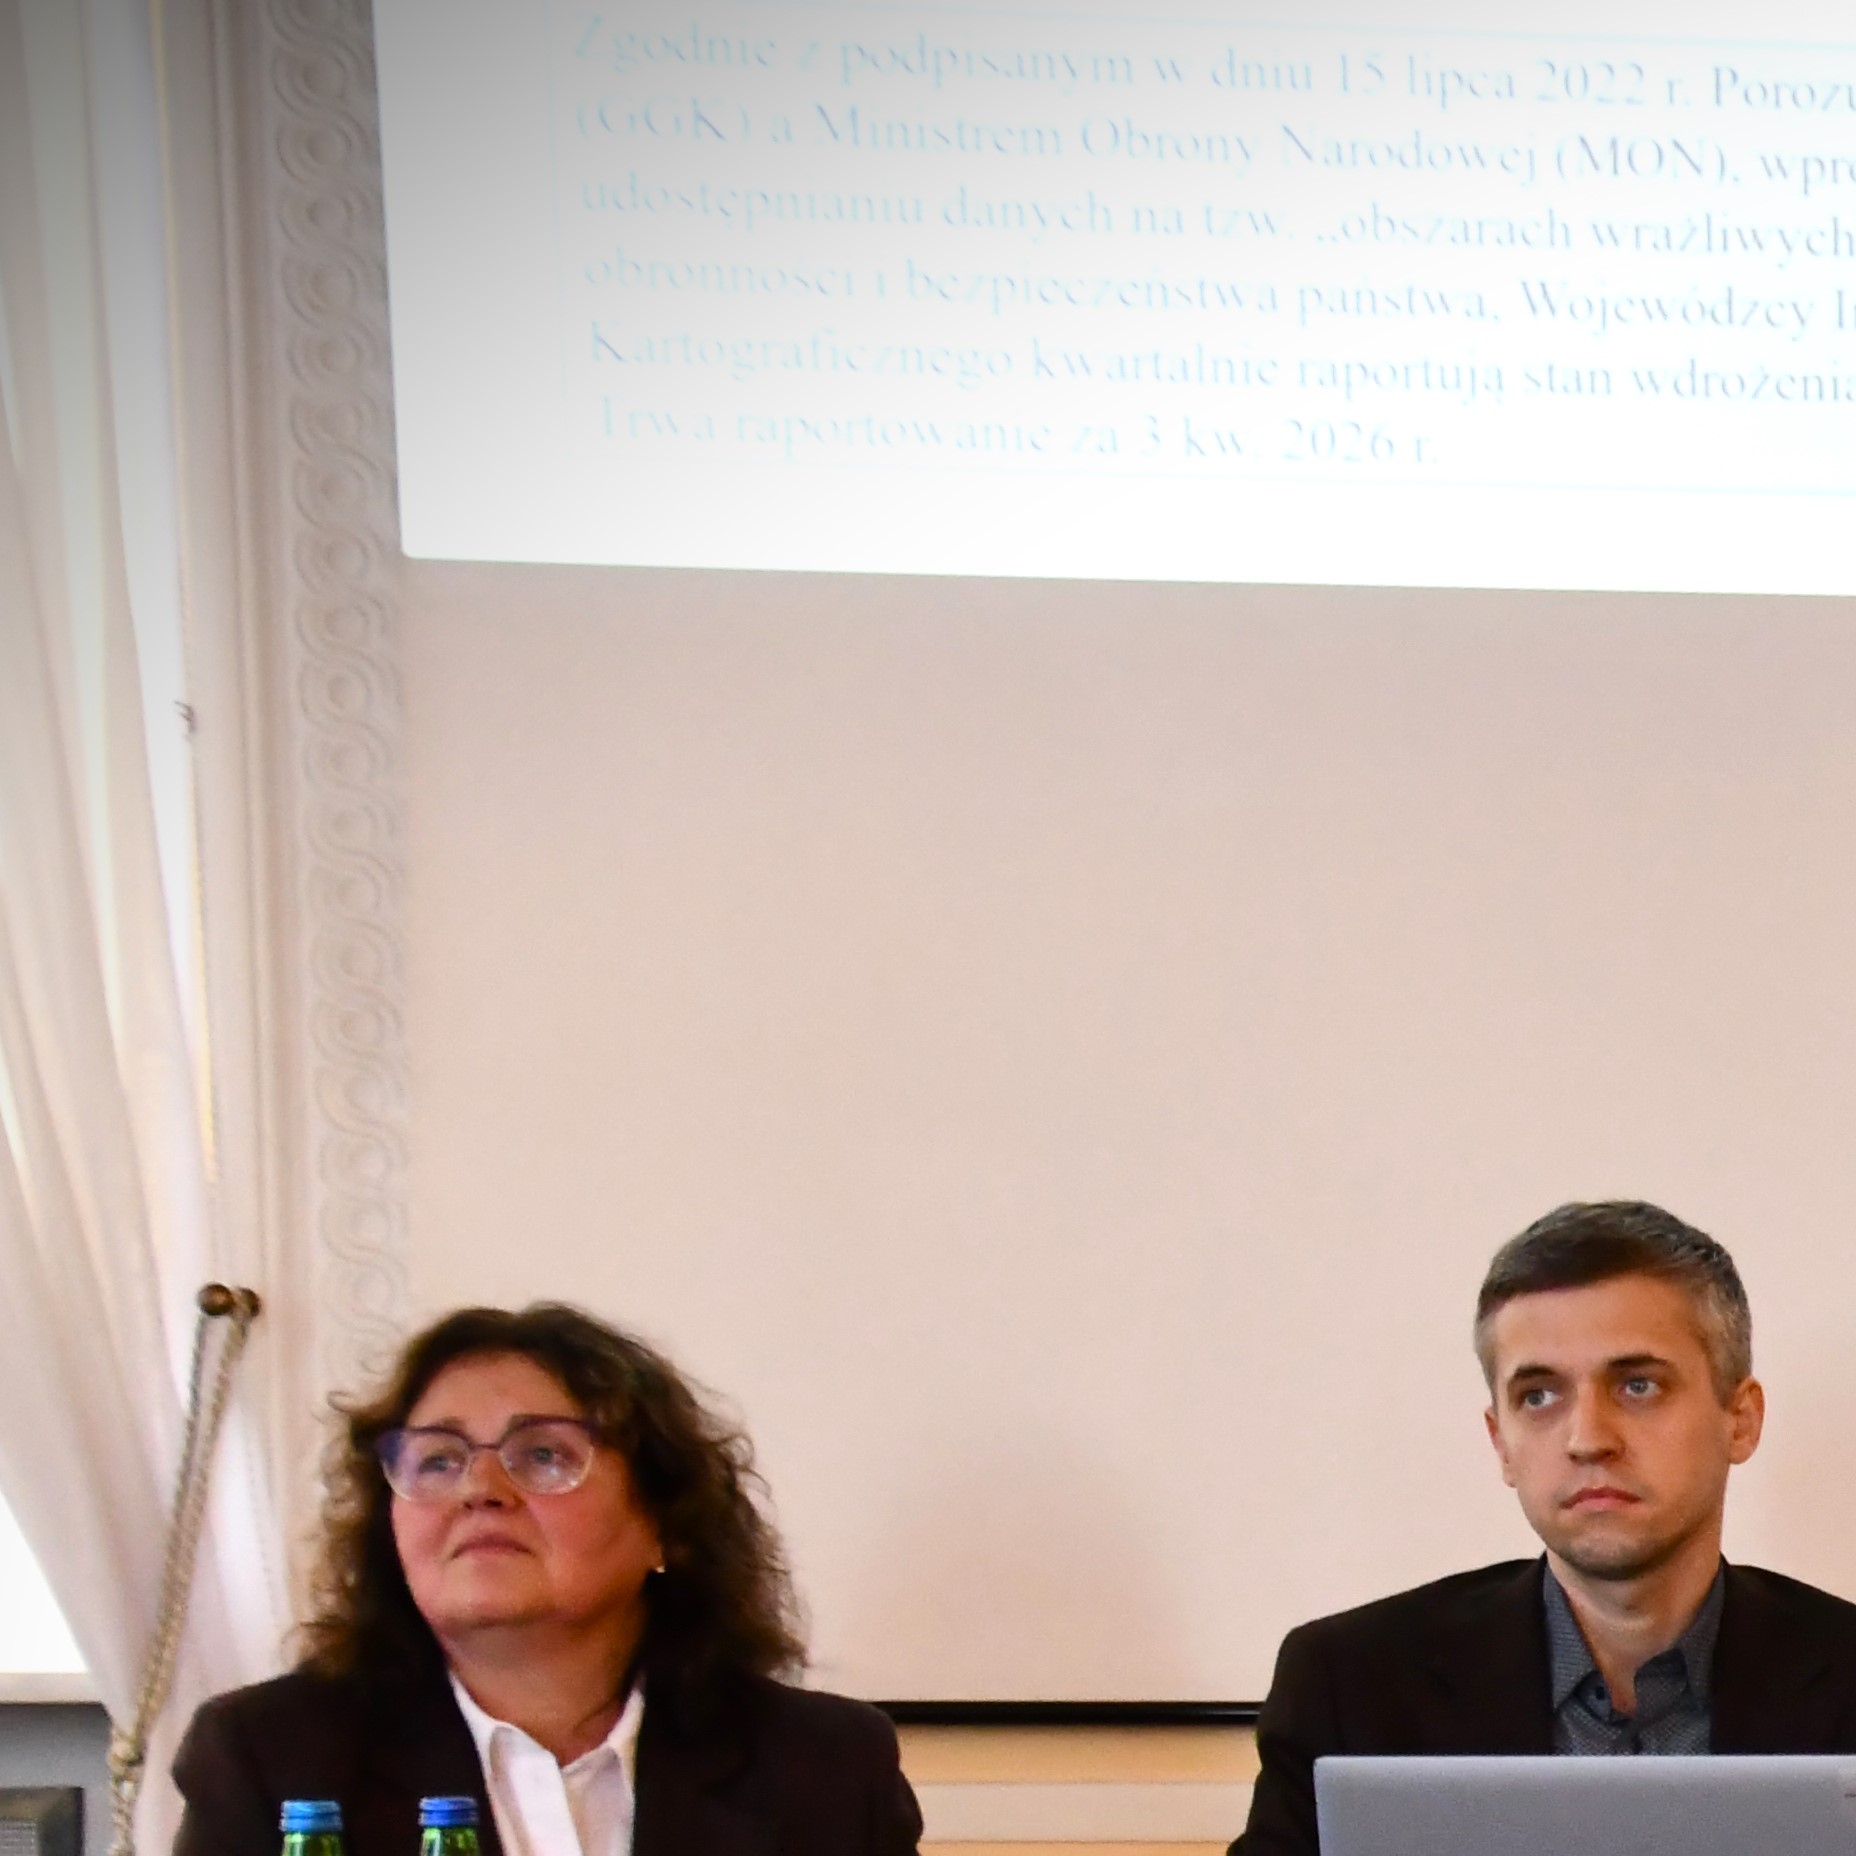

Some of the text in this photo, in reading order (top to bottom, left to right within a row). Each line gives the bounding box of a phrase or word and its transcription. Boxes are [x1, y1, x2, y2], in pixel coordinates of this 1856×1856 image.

[572, 15, 777, 74] Zgodnie
[800, 40, 820, 69] z
[840, 32, 1133, 89] podpisanym
[1154, 57, 1191, 84] w
[1210, 45, 1312, 91] dniu
[1339, 51, 1385, 94] 15
[1408, 53, 1516, 111] lipca
[1537, 58, 1644, 105] 2022
[576, 97, 751, 142] (GGK)
[769, 117, 792, 144] a
[814, 102, 1062, 155] Ministrem
[1080, 118, 1258, 176] Obrony
[1281, 124, 1535, 186] Narodowej
[1555, 134, 1739, 183] (MON),
[582, 170, 922, 231] udostępnianiu
[941, 184, 1112, 243] danych
[1133, 207, 1184, 235] na
[1203, 204, 1293, 239] tzw.
[584, 245, 853, 296] obronności
[872, 256, 889, 299] i
[906, 257, 1278, 316] bezpieczeństwa
[1299, 284, 1499, 327] państwa,
[1521, 280, 1813, 342] Wojewódzcy
[590, 320, 1012, 390] Kartograficznego
[1032, 336, 1279, 386] kwartalnie
[1299, 359, 1504, 406] raportują
[1524, 363, 1612, 396] stan
[601, 395, 715, 440] Trwa
[737, 415, 1051, 457] raportowanie
[1072, 426, 1118, 454] za
[1141, 414, 1163, 455] 3
[1184, 416, 1260, 458] kw.
[1283, 419, 1394, 462] 2026
